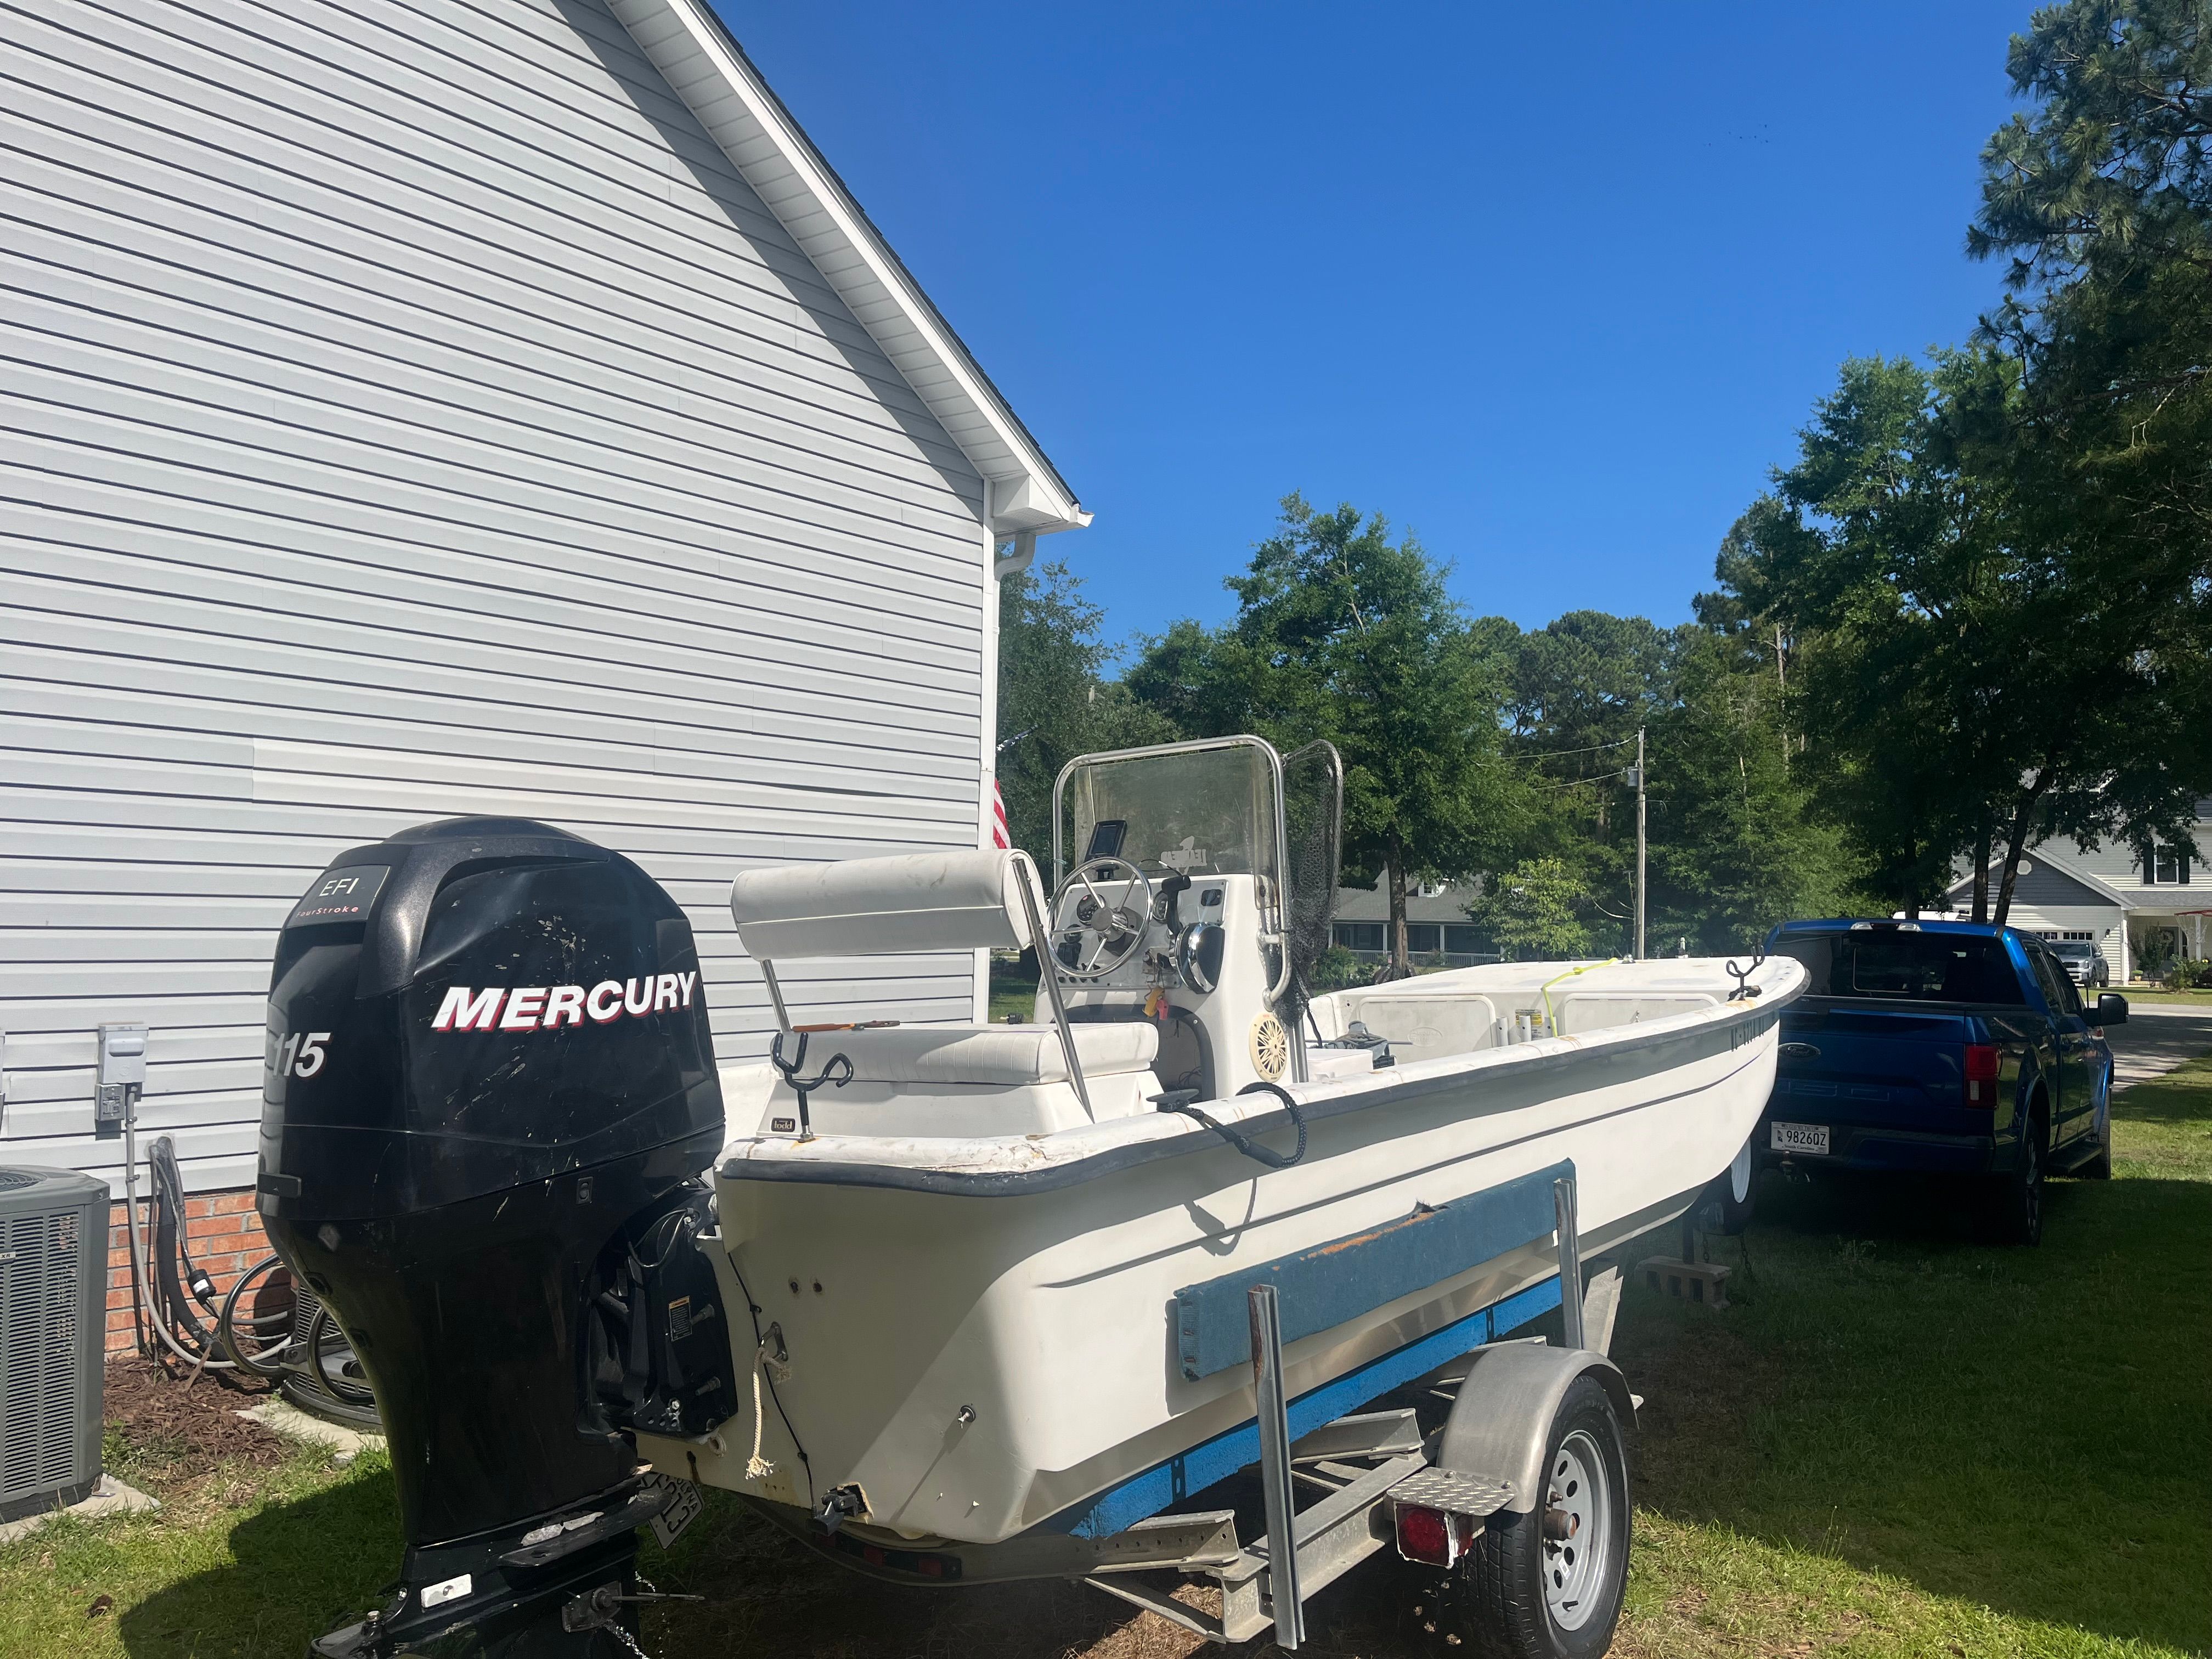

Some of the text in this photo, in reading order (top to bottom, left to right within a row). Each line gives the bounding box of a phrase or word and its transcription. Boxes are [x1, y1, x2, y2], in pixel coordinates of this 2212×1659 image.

[319, 877, 359, 897] EFI
[296, 905, 359, 917] FourStroke
[431, 971, 697, 1031] MERCURY
[273, 1032, 332, 1078] 115
[774, 1120, 792, 1129] todd
